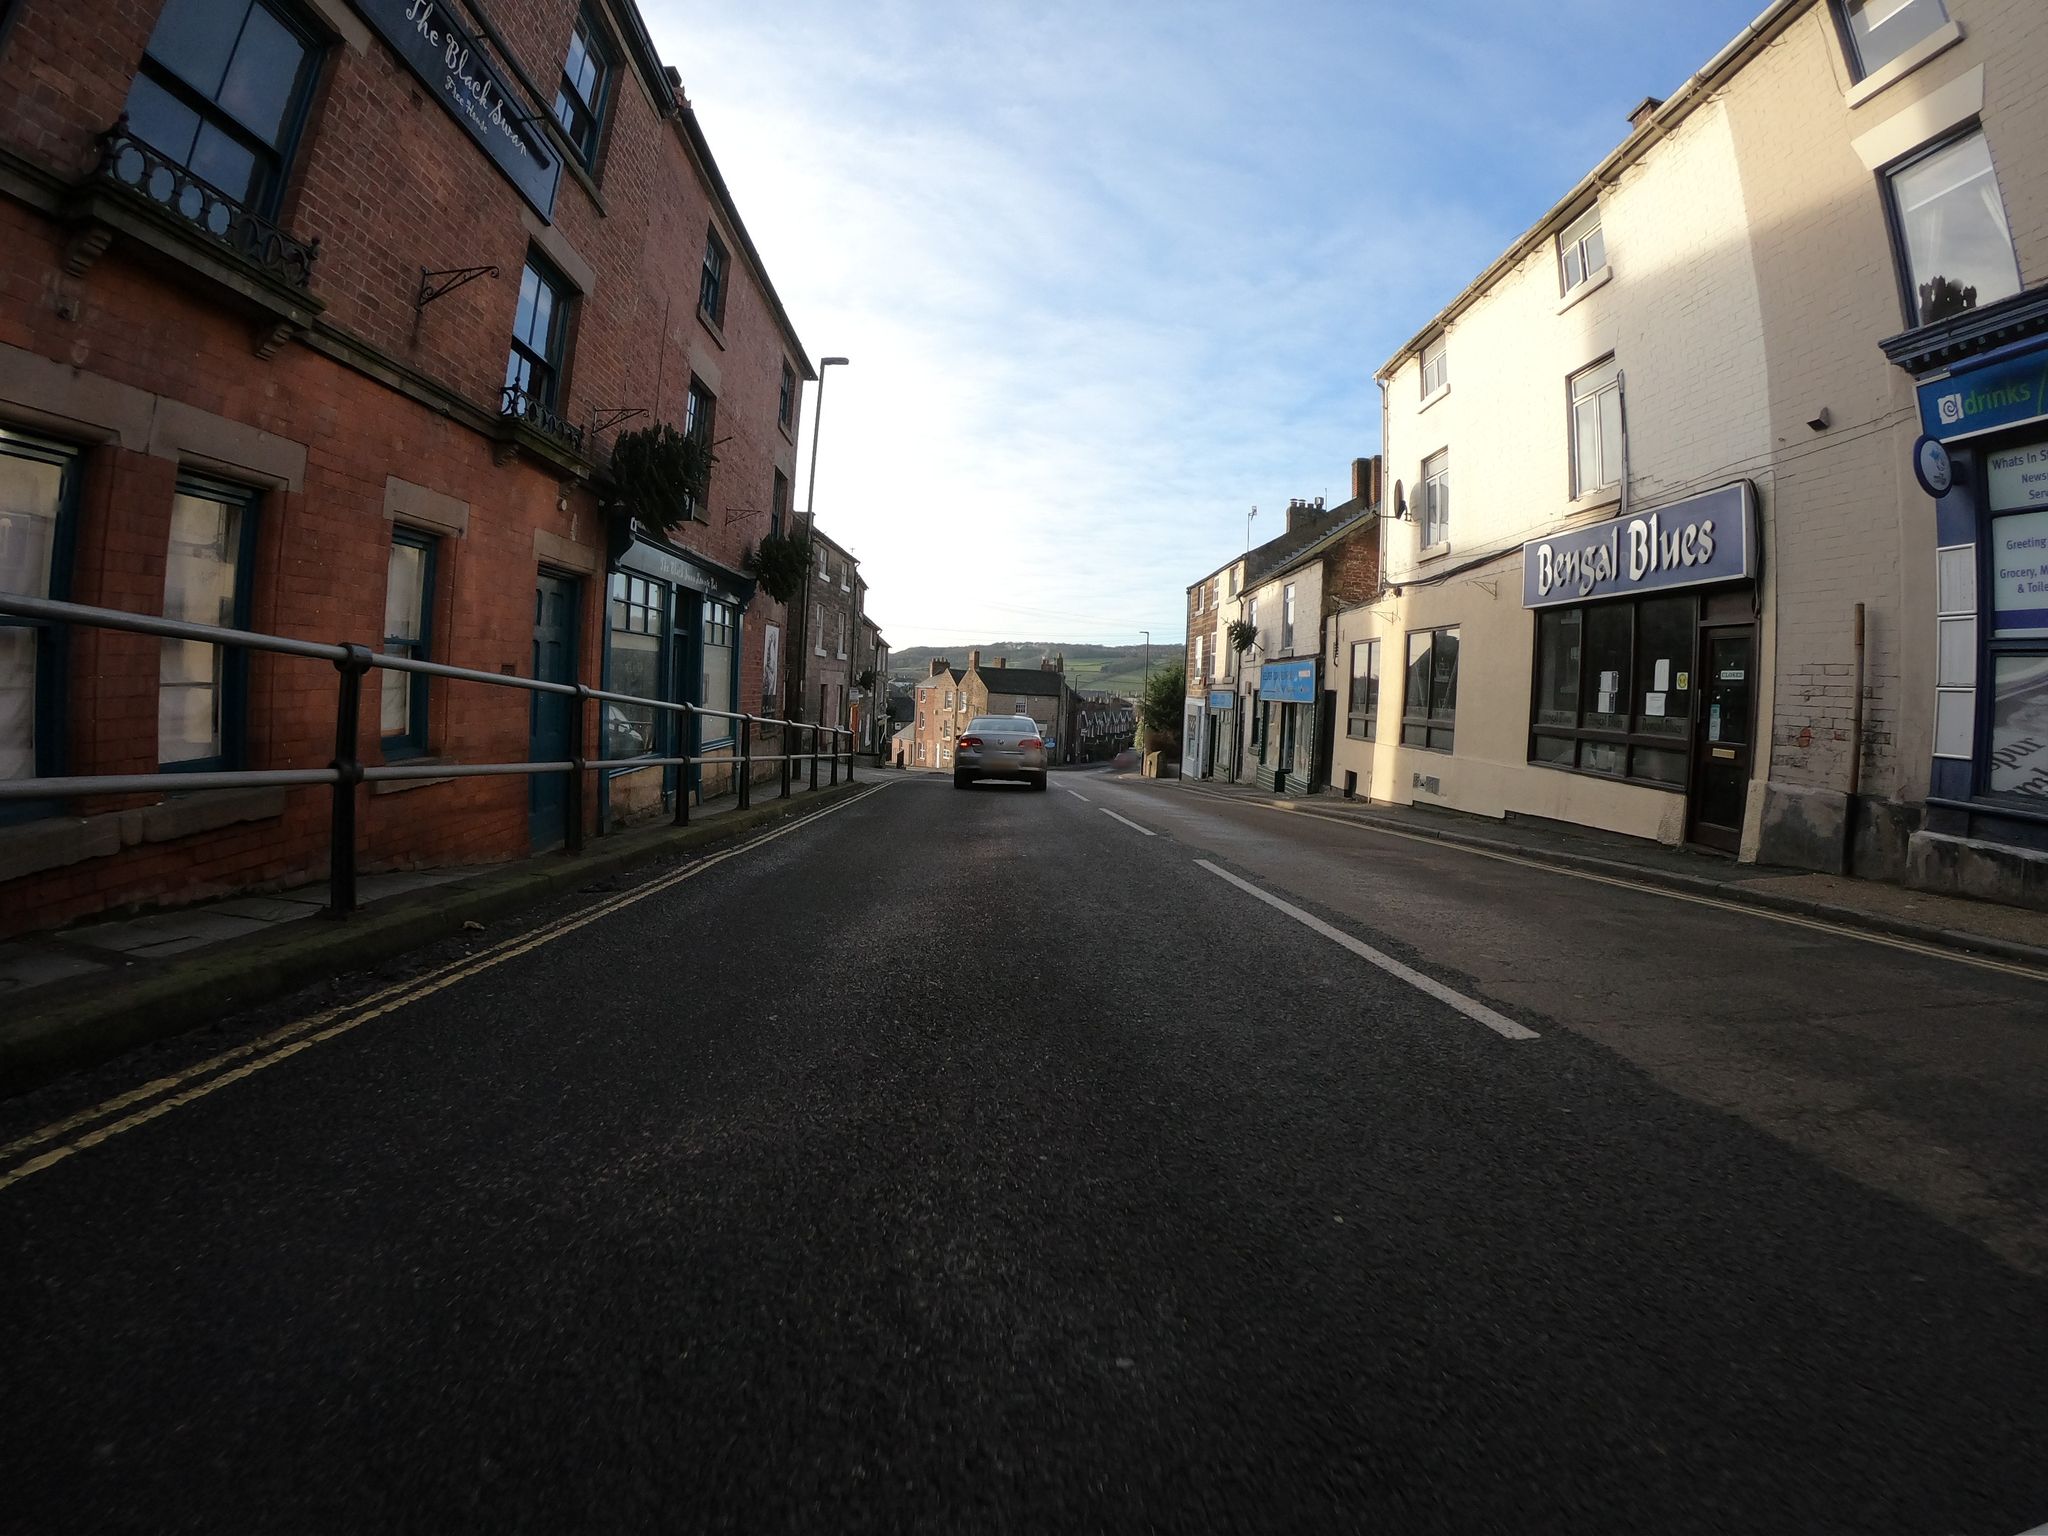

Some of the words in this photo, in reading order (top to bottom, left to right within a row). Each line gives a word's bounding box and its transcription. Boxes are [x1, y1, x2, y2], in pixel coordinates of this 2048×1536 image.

[406, 0, 439, 47] The
[445, 33, 491, 109] Black
[488, 99, 528, 157] Swan
[444, 75, 465, 107] Free
[465, 101, 488, 135] House
[1965, 382, 2031, 415] drinks
[1992, 456, 2025, 471] Whats
[2027, 452, 2037, 464] In
[2022, 472, 2048, 485] News
[2006, 536, 2047, 551] Greeting
[1536, 525, 1618, 597] Bengal
[1626, 512, 1715, 582] Blues
[1999, 567, 2038, 581] Grocery,
[2017, 584, 2025, 594] &
